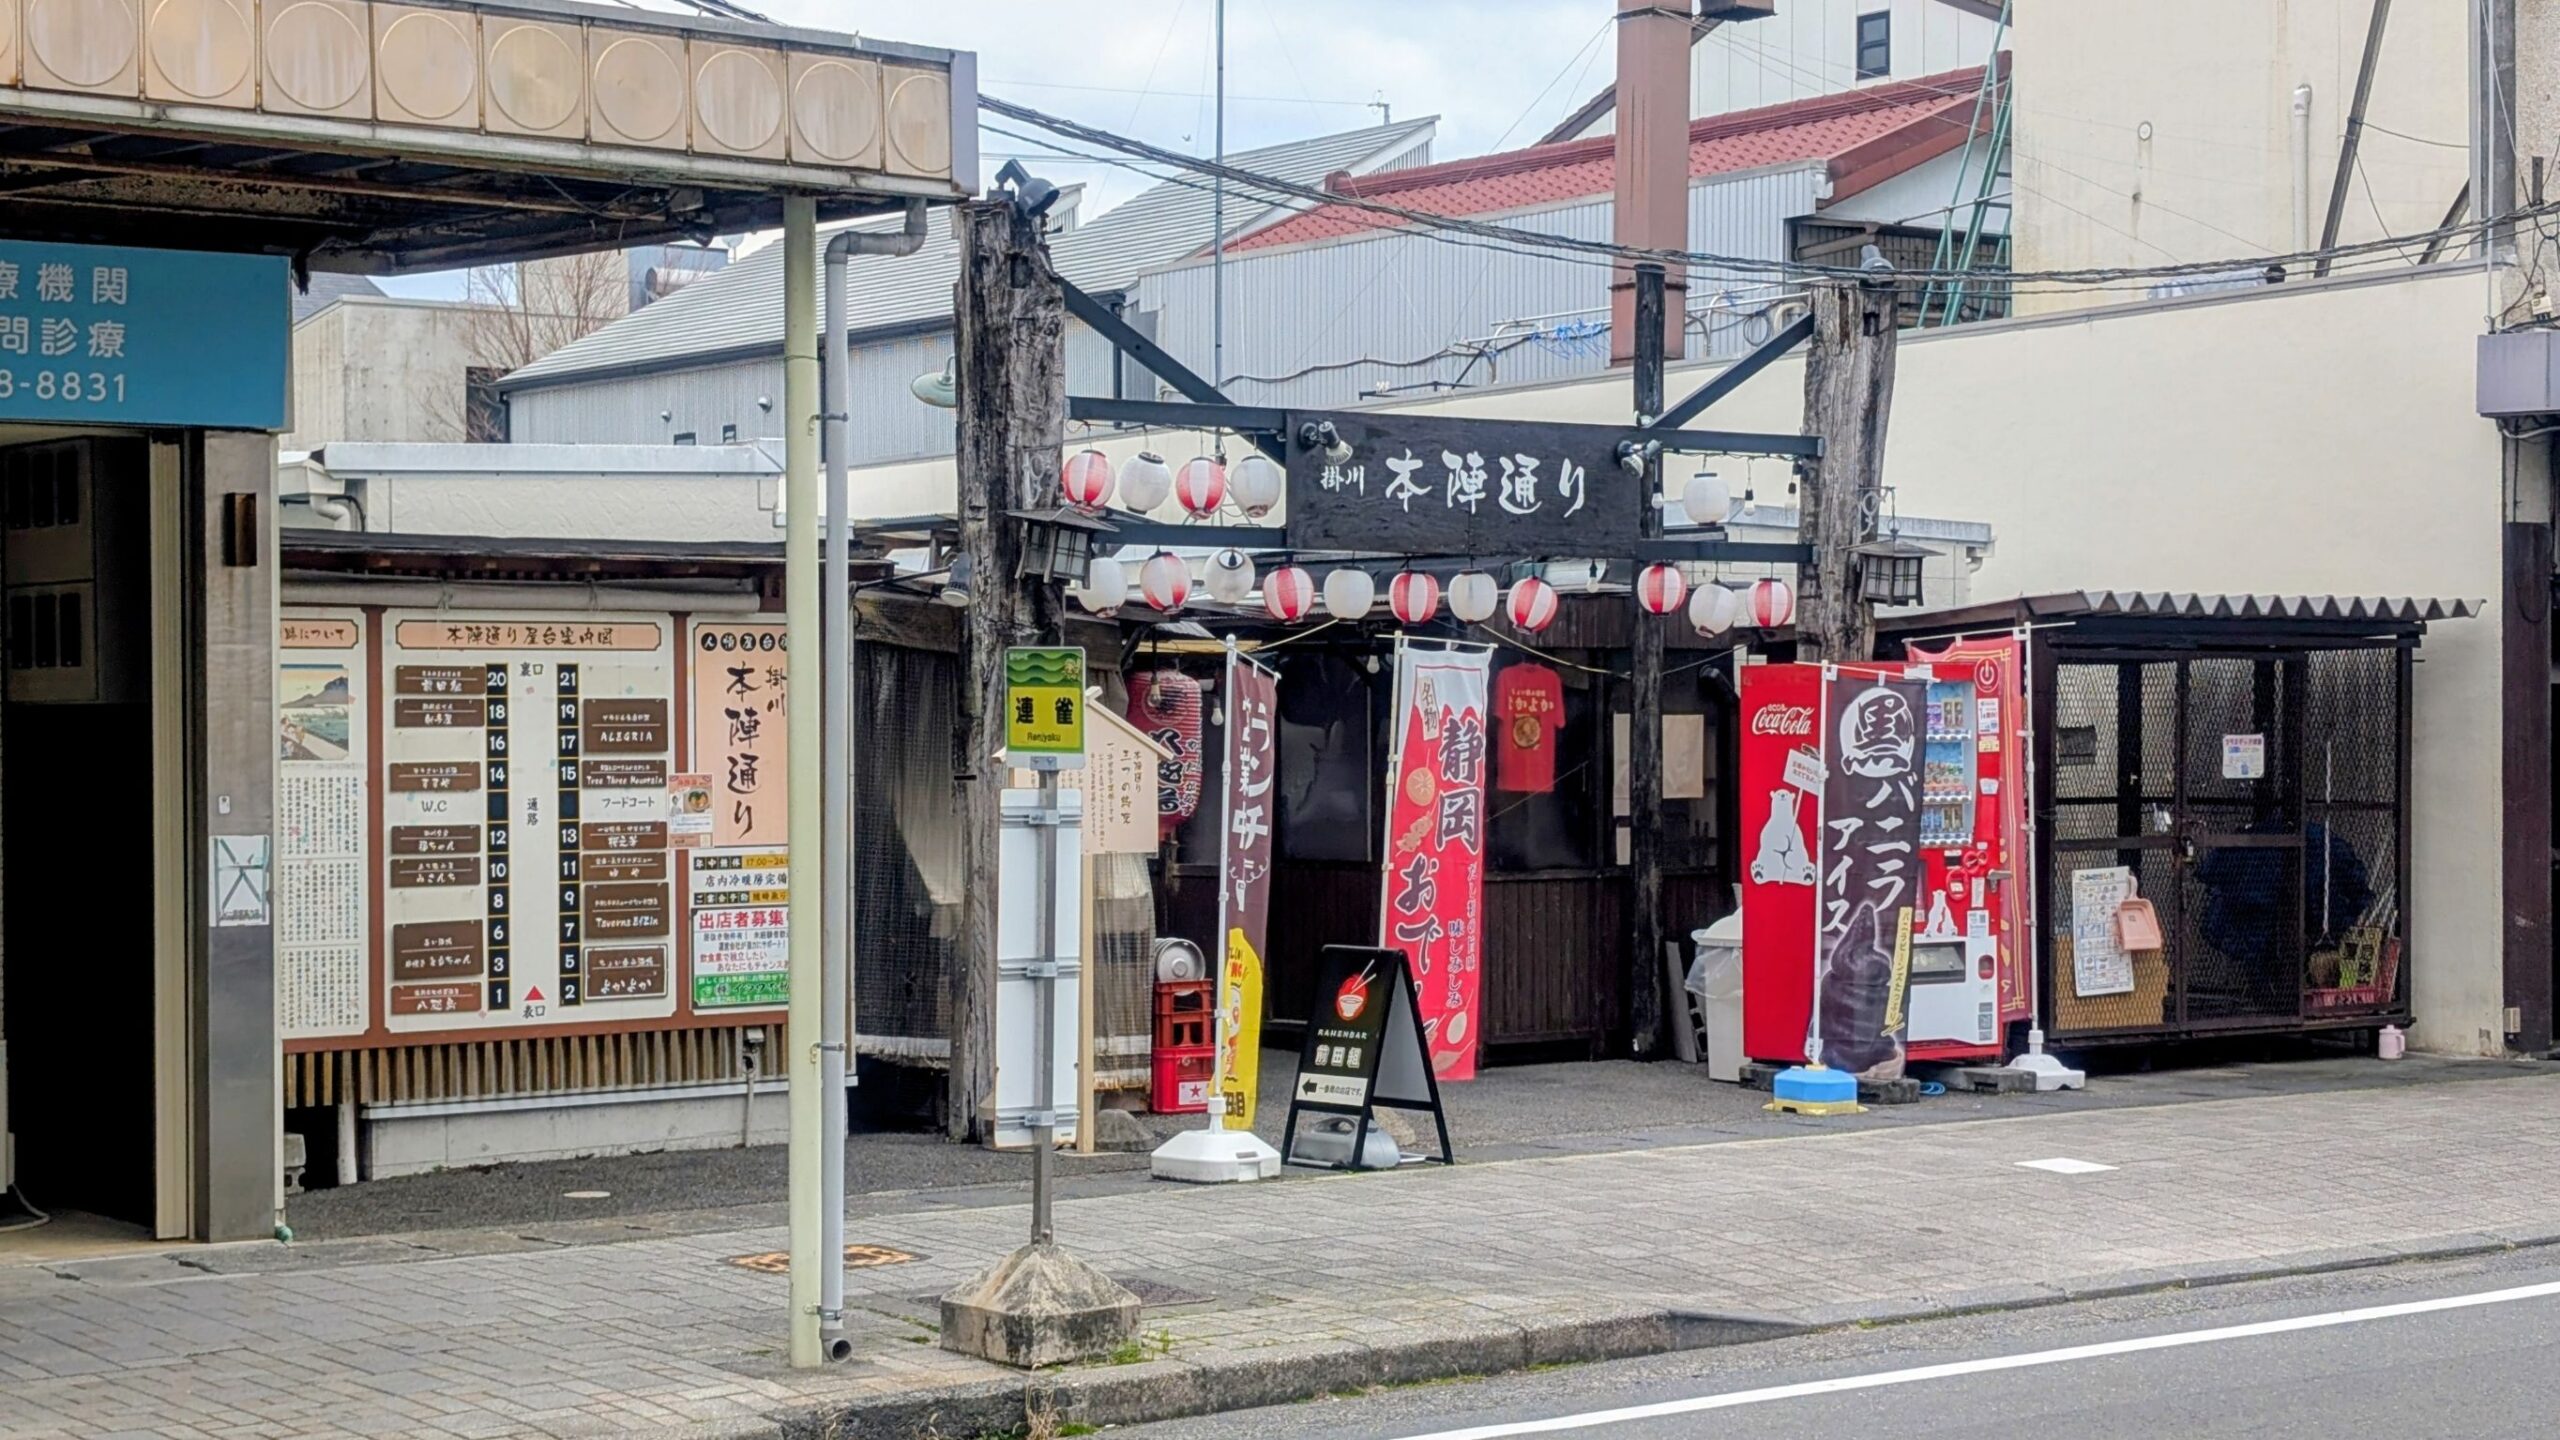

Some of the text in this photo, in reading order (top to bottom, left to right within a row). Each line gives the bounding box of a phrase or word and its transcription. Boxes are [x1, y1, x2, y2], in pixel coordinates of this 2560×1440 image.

[0, 369, 125, 402] 8-8831
[1320, 465, 1365, 497] 掛川
[1386, 448, 1585, 518] 本陣通り
[487, 672, 507, 687] 20
[559, 672, 576, 687] 21
[489, 704, 506, 719] 18
[560, 704, 576, 719] 19
[1016, 696, 1074, 725] 連雀
[1421, 681, 1438, 733] 名物
[1751, 706, 1816, 735] Coca-Cola
[489, 735, 506, 750] 16
[560, 734, 576, 750] 17
[600, 731, 653, 742] ALEGRIA
[724, 660, 763, 840] 本陣通り
[489, 767, 506, 782] 14
[561, 766, 577, 781] 15
[1435, 714, 1483, 856] 静岡
[601, 796, 656, 808] フードコート
[527, 797, 539, 826] 通路
[490, 830, 507, 845] 12
[561, 828, 577, 843] 13
[1866, 772, 1918, 912] バニラ
[490, 863, 507, 878] 10
[562, 860, 577, 876] 11
[1821, 816, 1864, 934] アイス
[494, 895, 504, 909] 8
[564, 891, 575, 906] 9
[699, 908, 788, 930] 出店者募集
[493, 925, 504, 940] 6
[564, 922, 575, 938] 7
[1396, 852, 1444, 1036] おで
[493, 957, 504, 972] 3
[565, 954, 575, 968] 5
[1446, 918, 1465, 1009] 味しみしみ
[564, 984, 576, 999] 2
[601, 978, 652, 995] よかよか
[496, 988, 502, 1003] 1
[522, 1005, 546, 1018] 表口
